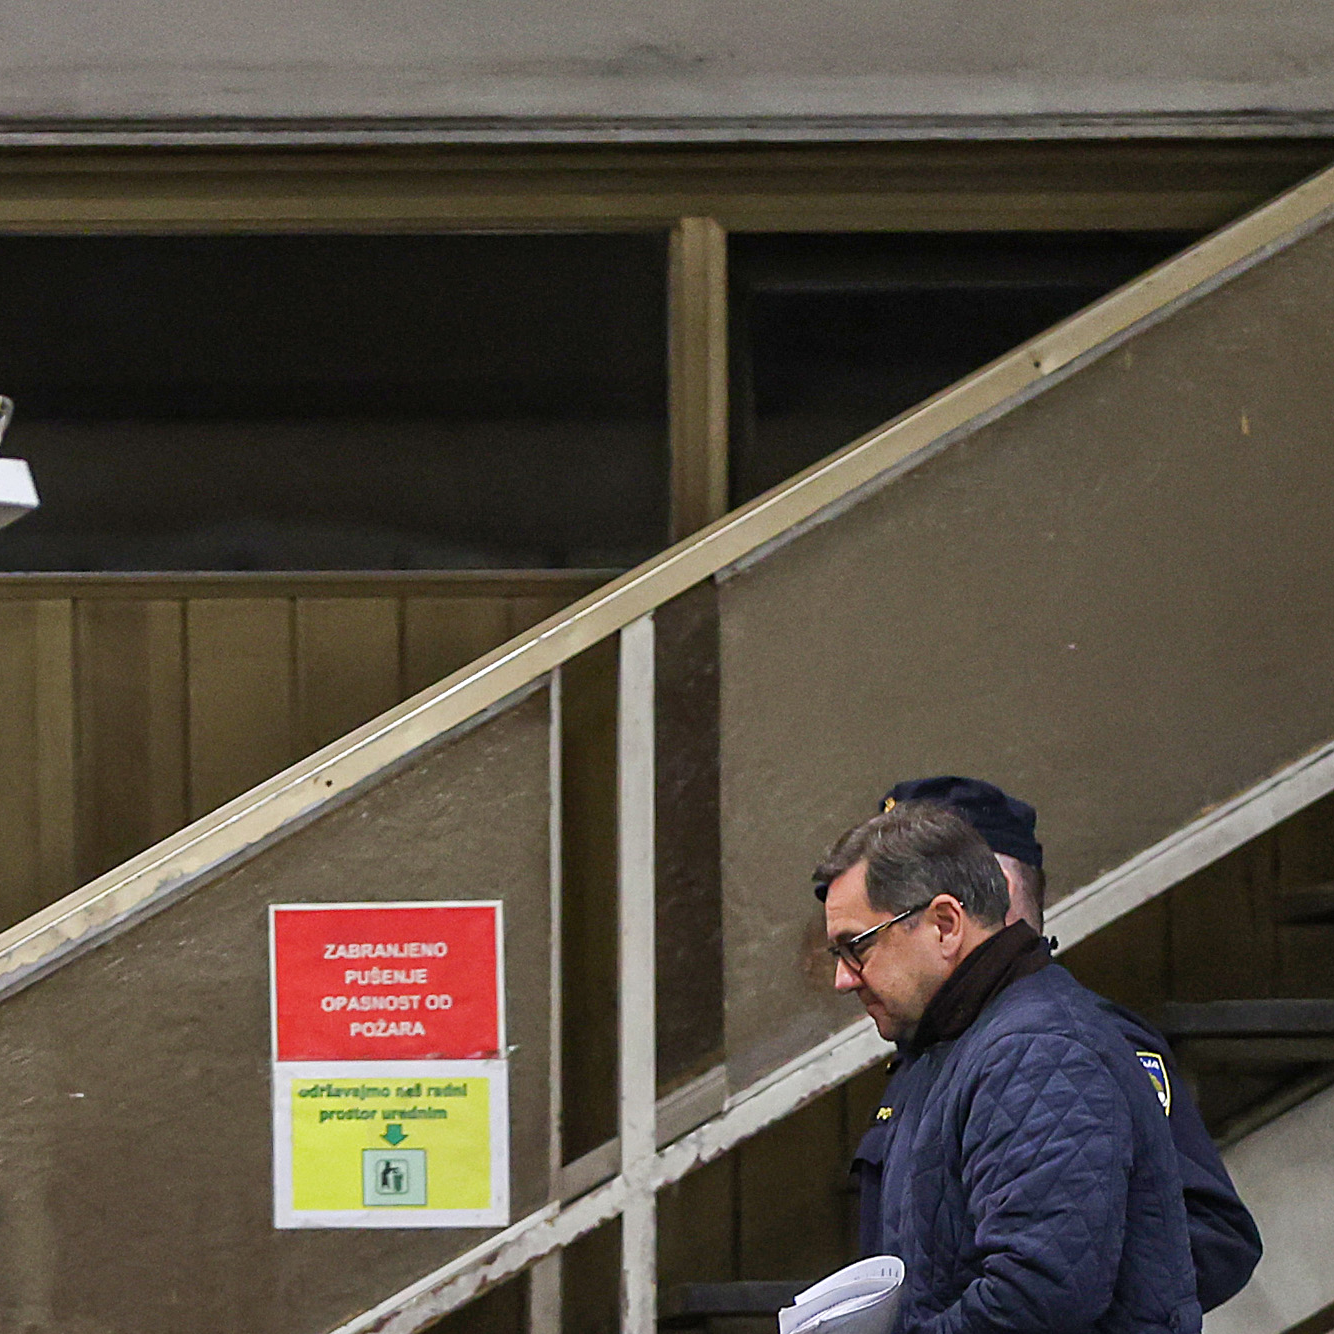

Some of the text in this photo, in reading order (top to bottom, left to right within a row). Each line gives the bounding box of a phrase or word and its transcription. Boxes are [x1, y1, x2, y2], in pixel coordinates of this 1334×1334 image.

[323, 942, 448, 959] ZABRANJENO
[344, 966, 428, 985] PUŠENJE
[321, 993, 453, 1012] OPASNOST OD
[349, 1018, 426, 1037] POŽARA
[319, 1107, 378, 1123] prostor
